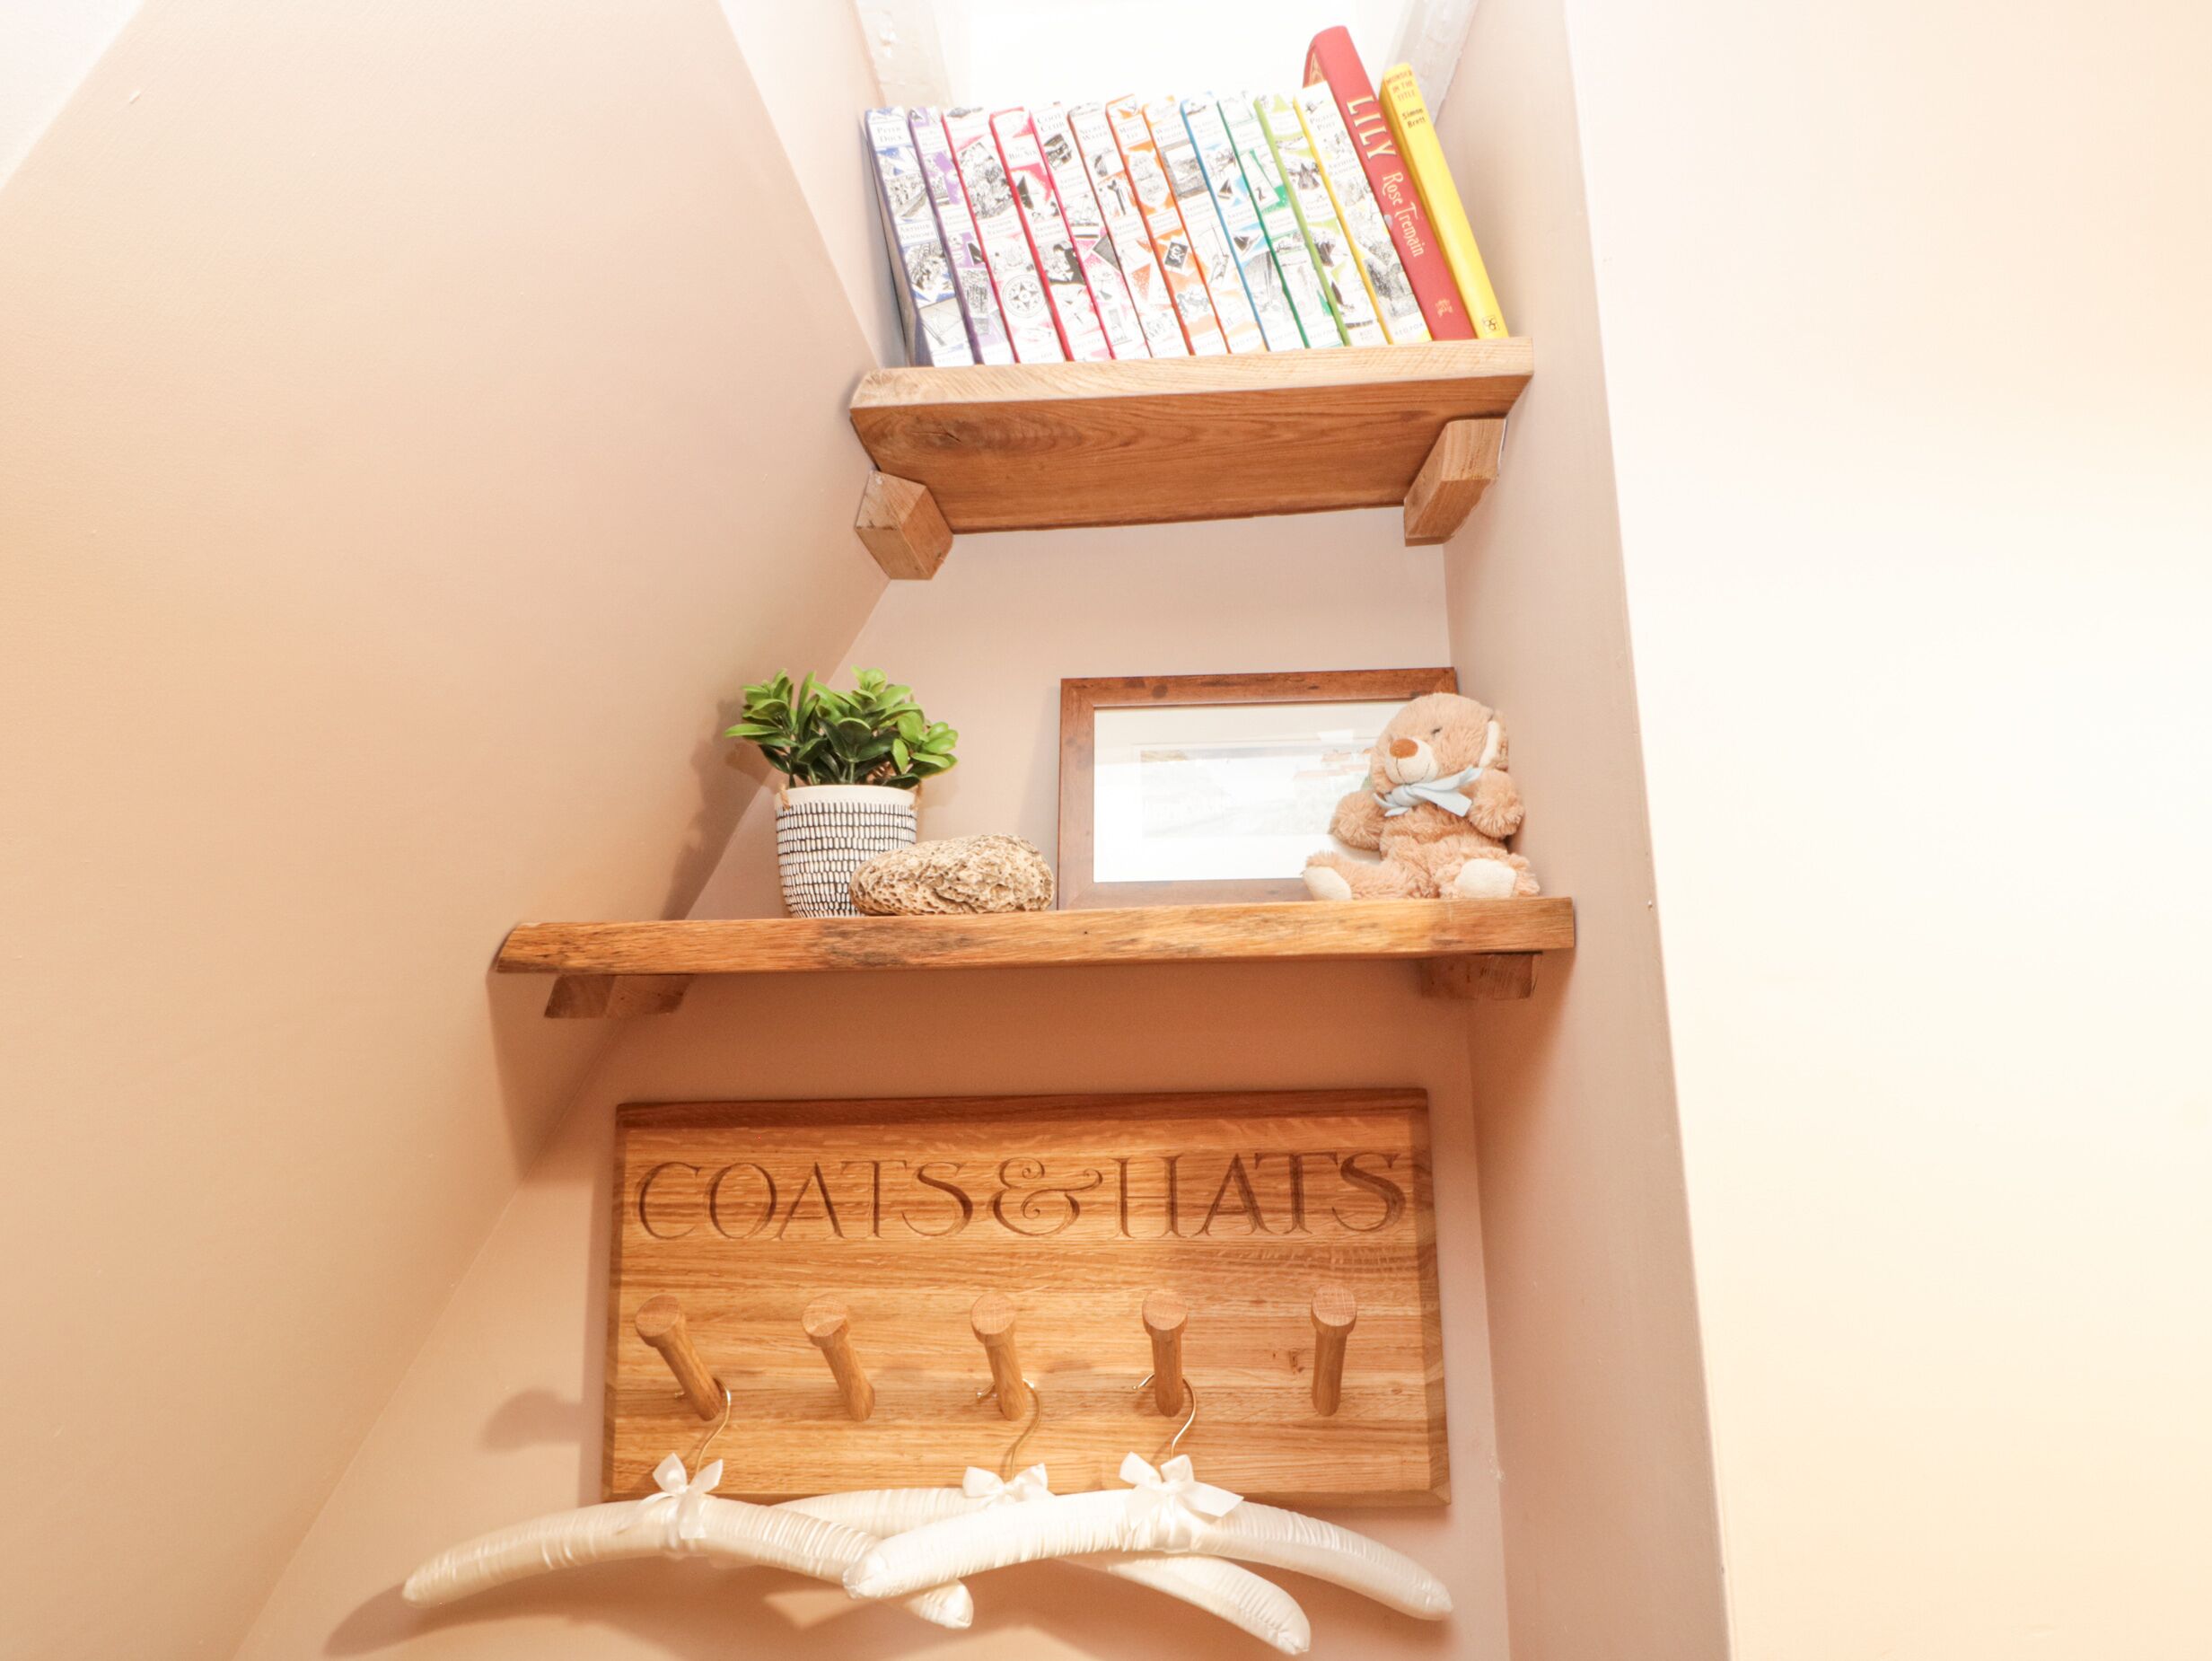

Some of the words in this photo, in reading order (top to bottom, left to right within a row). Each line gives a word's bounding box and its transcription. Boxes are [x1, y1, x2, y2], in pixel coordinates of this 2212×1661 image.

[1402, 108, 1424, 120] Simon
[1408, 116, 1426, 128] Brett
[1347, 94, 1397, 160] LILY
[1382, 171, 1404, 205] Rose
[1394, 201, 1425, 258] Tremain
